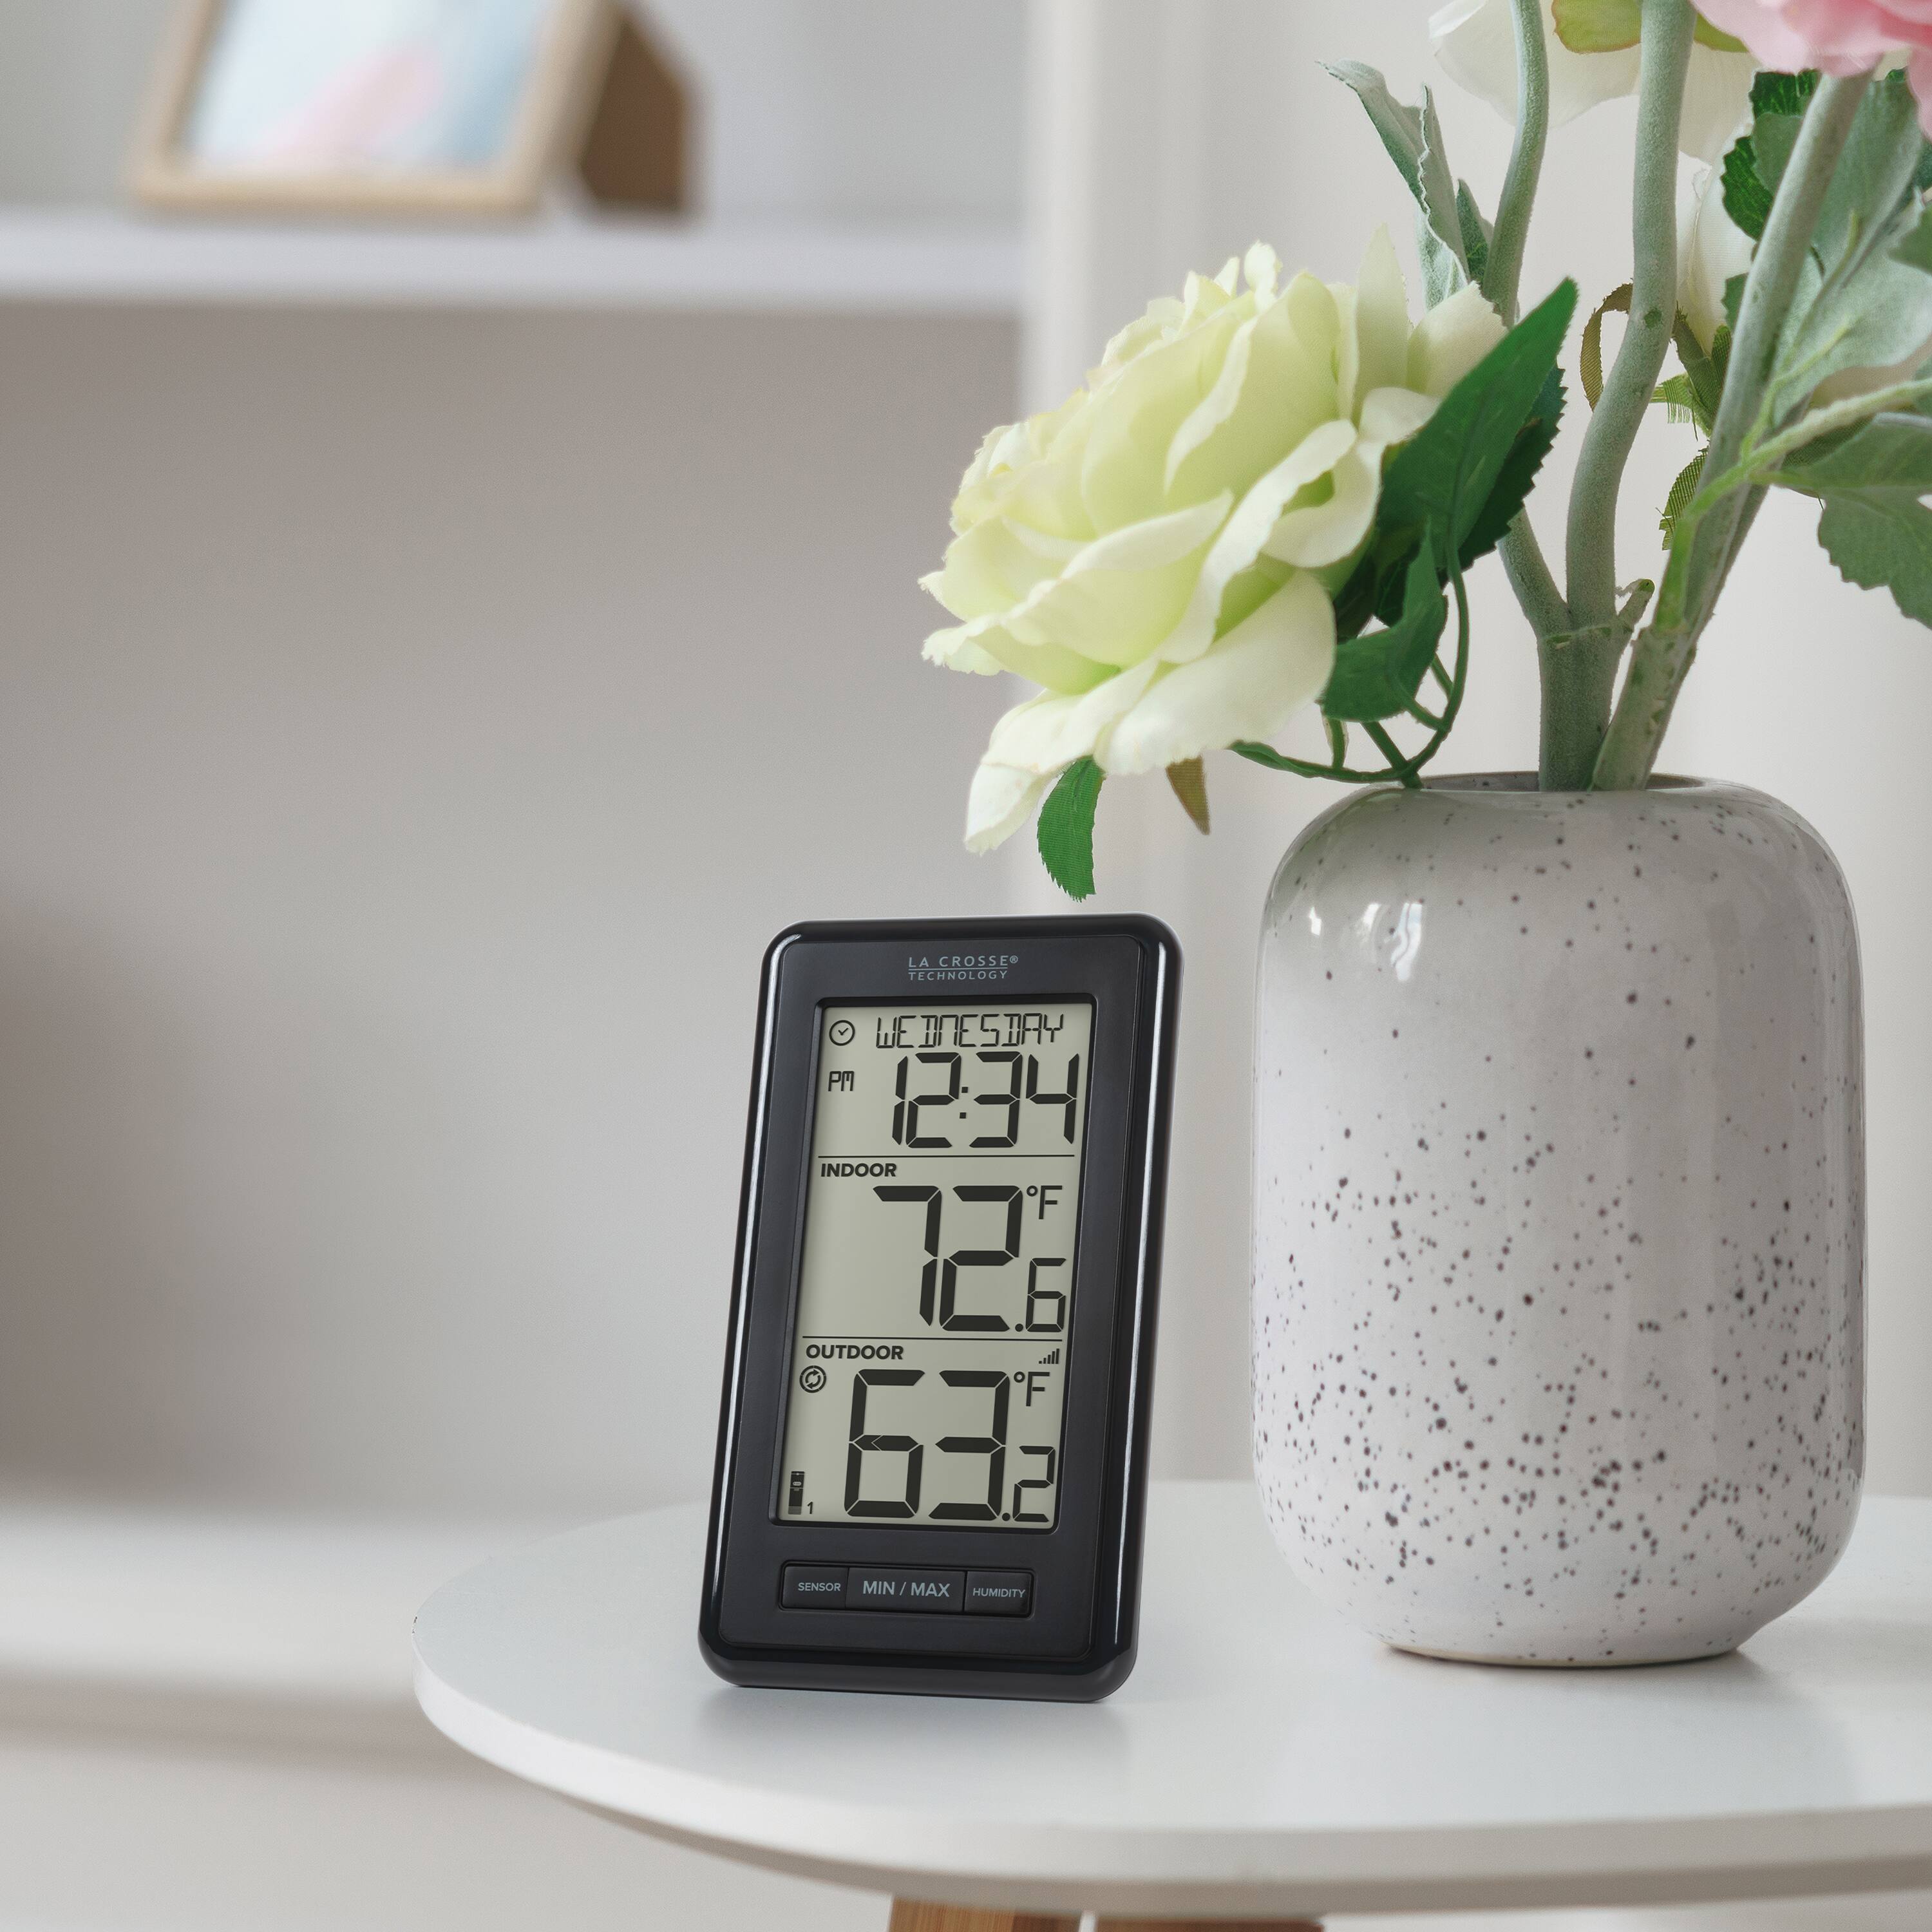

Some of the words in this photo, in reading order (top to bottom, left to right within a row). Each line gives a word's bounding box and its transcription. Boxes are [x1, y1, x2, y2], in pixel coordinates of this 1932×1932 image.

[908, 956, 929, 968] LA
[908, 970, 1008, 981] TECHNOLOGY
[875, 1012, 1064, 1049] WEDNESDAY
[828, 1070, 855, 1092] PM
[891, 1050, 1080, 1149] 12:34
[820, 1162, 897, 1178] INDOOR
[805, 1344, 905, 1360] OUTDOOR
[807, 1501, 813, 1515] 1
[797, 1582, 842, 1592] SENSOR
[862, 1580, 895, 1596] MIN
[910, 1582, 951, 1598] MAX
[972, 1587, 1026, 1599] HUMIDITY
